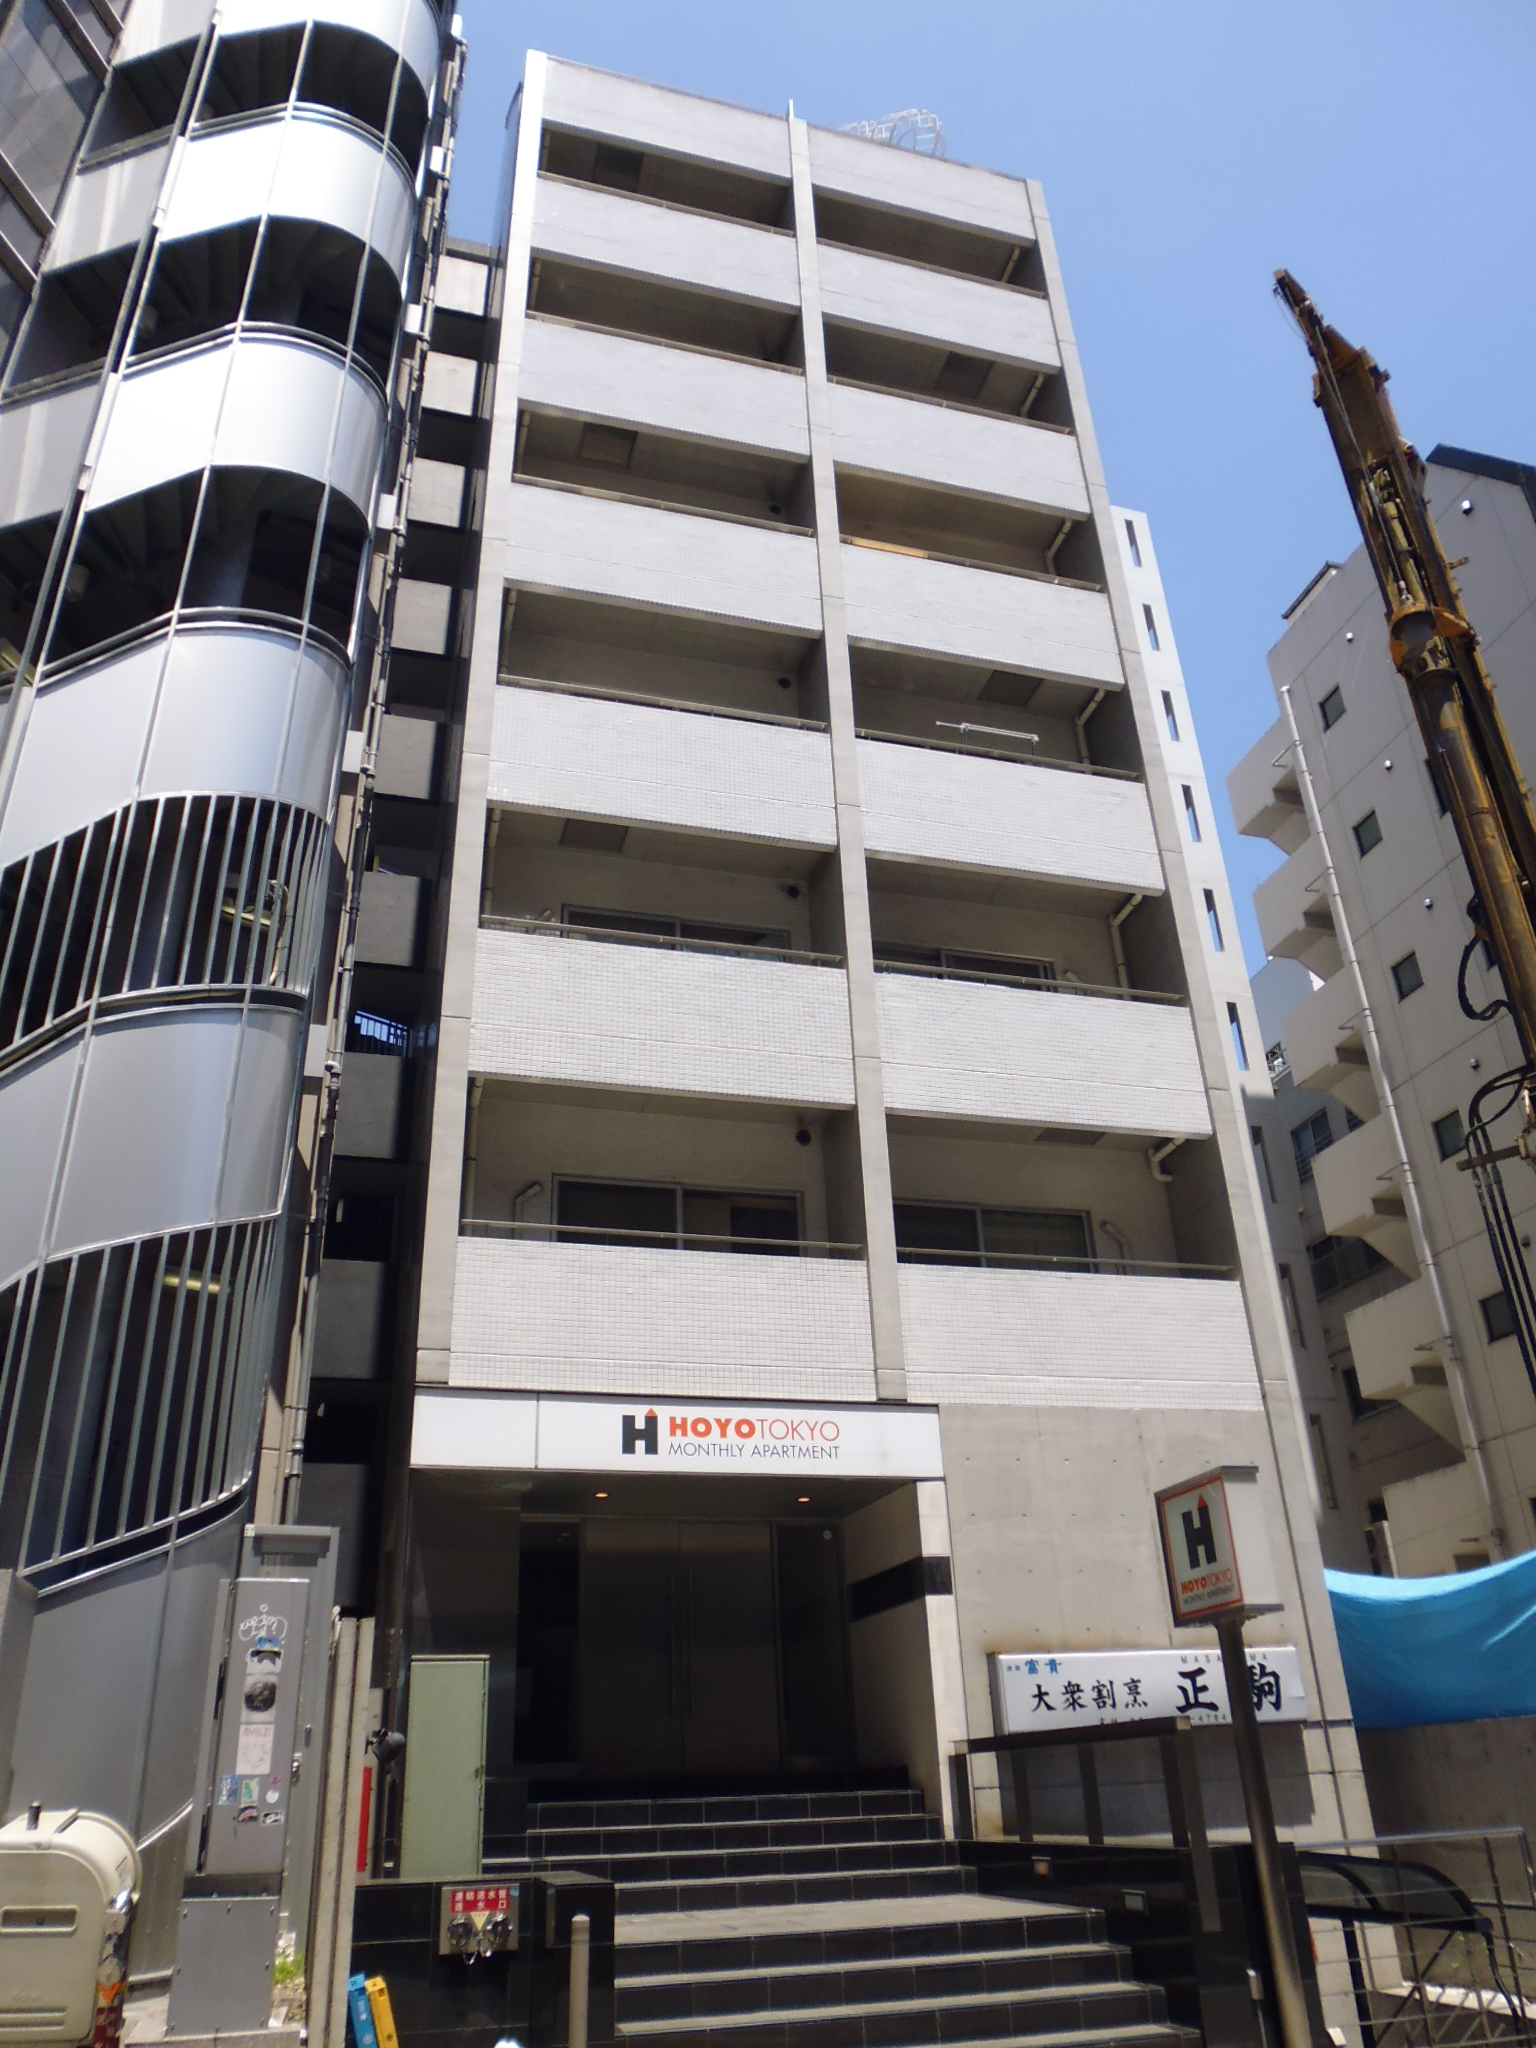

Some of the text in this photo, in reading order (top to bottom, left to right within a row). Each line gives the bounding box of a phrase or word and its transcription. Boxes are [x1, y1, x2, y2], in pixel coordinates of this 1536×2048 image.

[668, 1442, 840, 1460] MONTHLY APARTMENT
[1181, 1652, 1269, 1665] MASAMA
[1031, 1677, 1148, 1713] 大衆割烹
